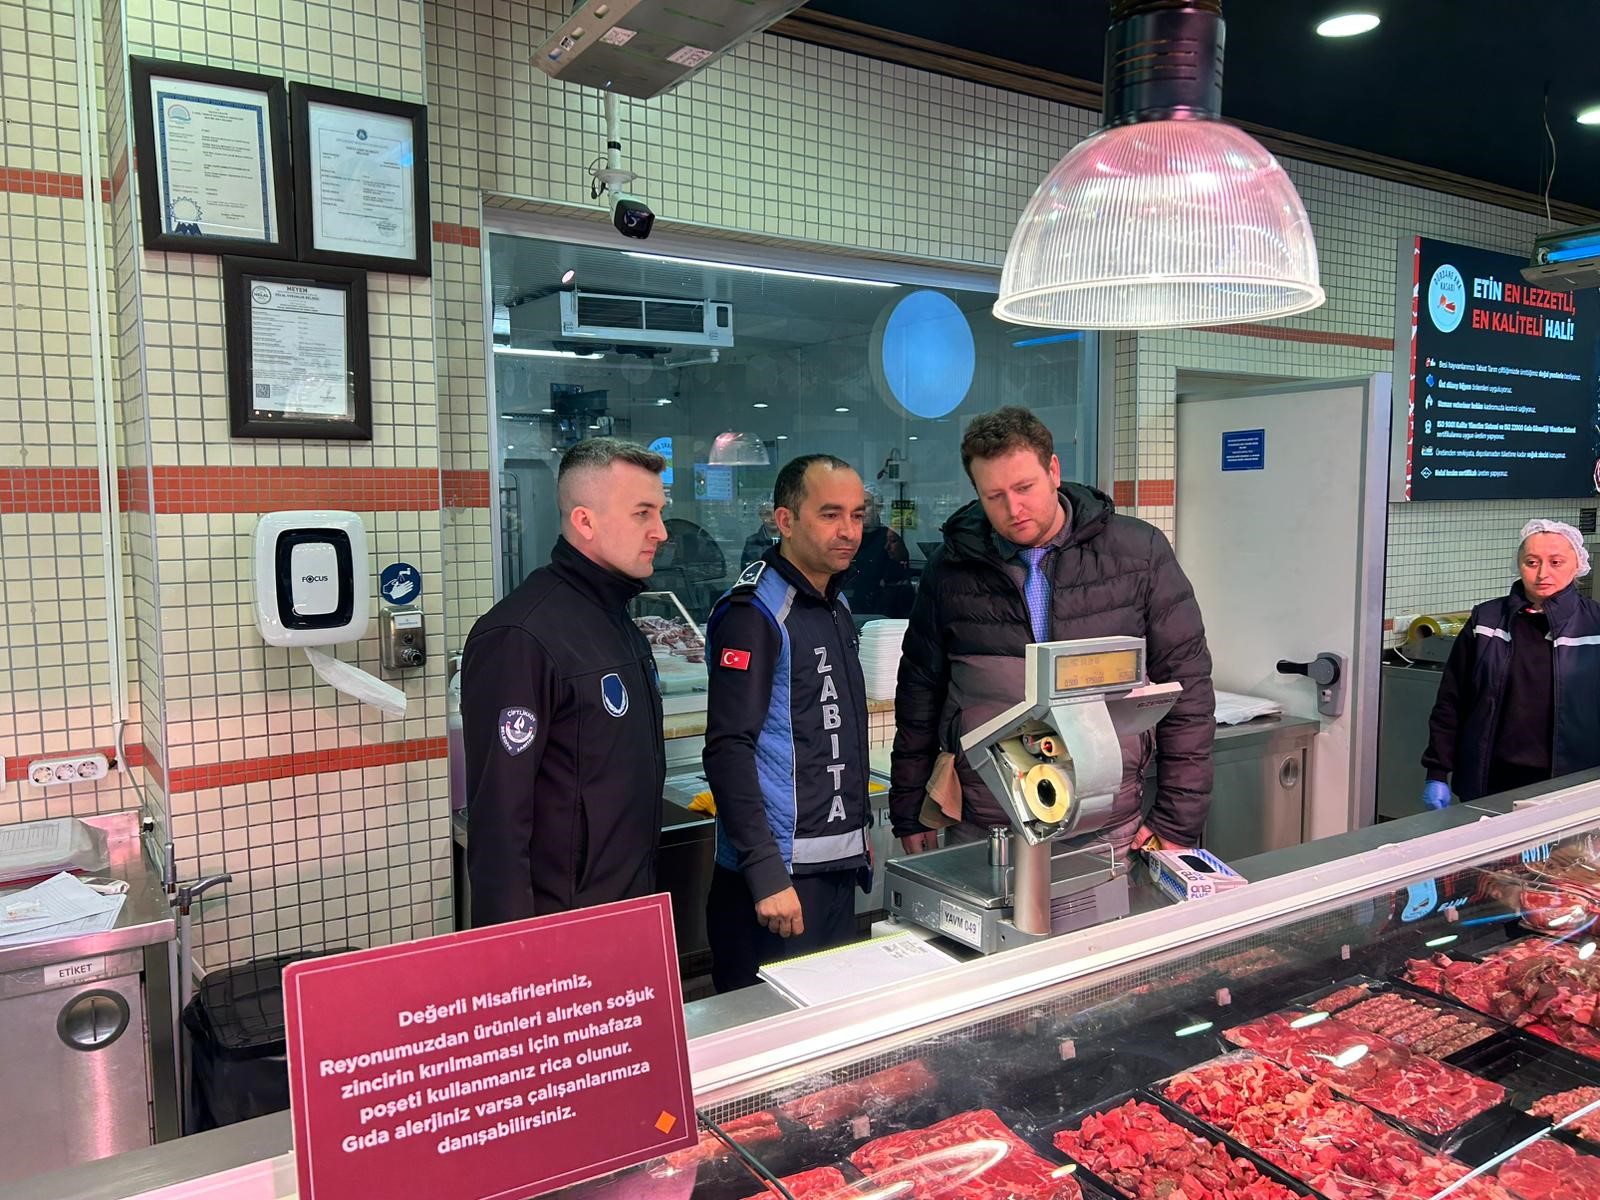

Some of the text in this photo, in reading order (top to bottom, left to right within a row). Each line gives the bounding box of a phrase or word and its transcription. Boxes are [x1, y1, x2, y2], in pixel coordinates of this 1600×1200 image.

[1473, 276, 1576, 316] ETİN EN LEZZETLİ,
[1472, 309, 1574, 340] EN KALİTELİ HALİ!
[302, 575, 328, 583] FOCUS
[814, 646, 846, 823] ZABITA
[1191, 885, 1211, 893] one
[944, 912, 977, 934] YAVM 049
[59, 963, 92, 977] ETİKET
[398, 973, 592, 1028] Değerli Misafirlerimiz,
[319, 985, 655, 1077] Reyonumuzdan ürünleri alırken soğuk
[341, 1015, 642, 1099] zincirin kırılmaması için muhafaza
[342, 1060, 650, 1153] Gıda alerjiniz varsa çalışanlarımıza
[360, 1041, 632, 1124] poşeti kullanmanız rica olunur.
[437, 1104, 577, 1154] danışabilirsiniz.
